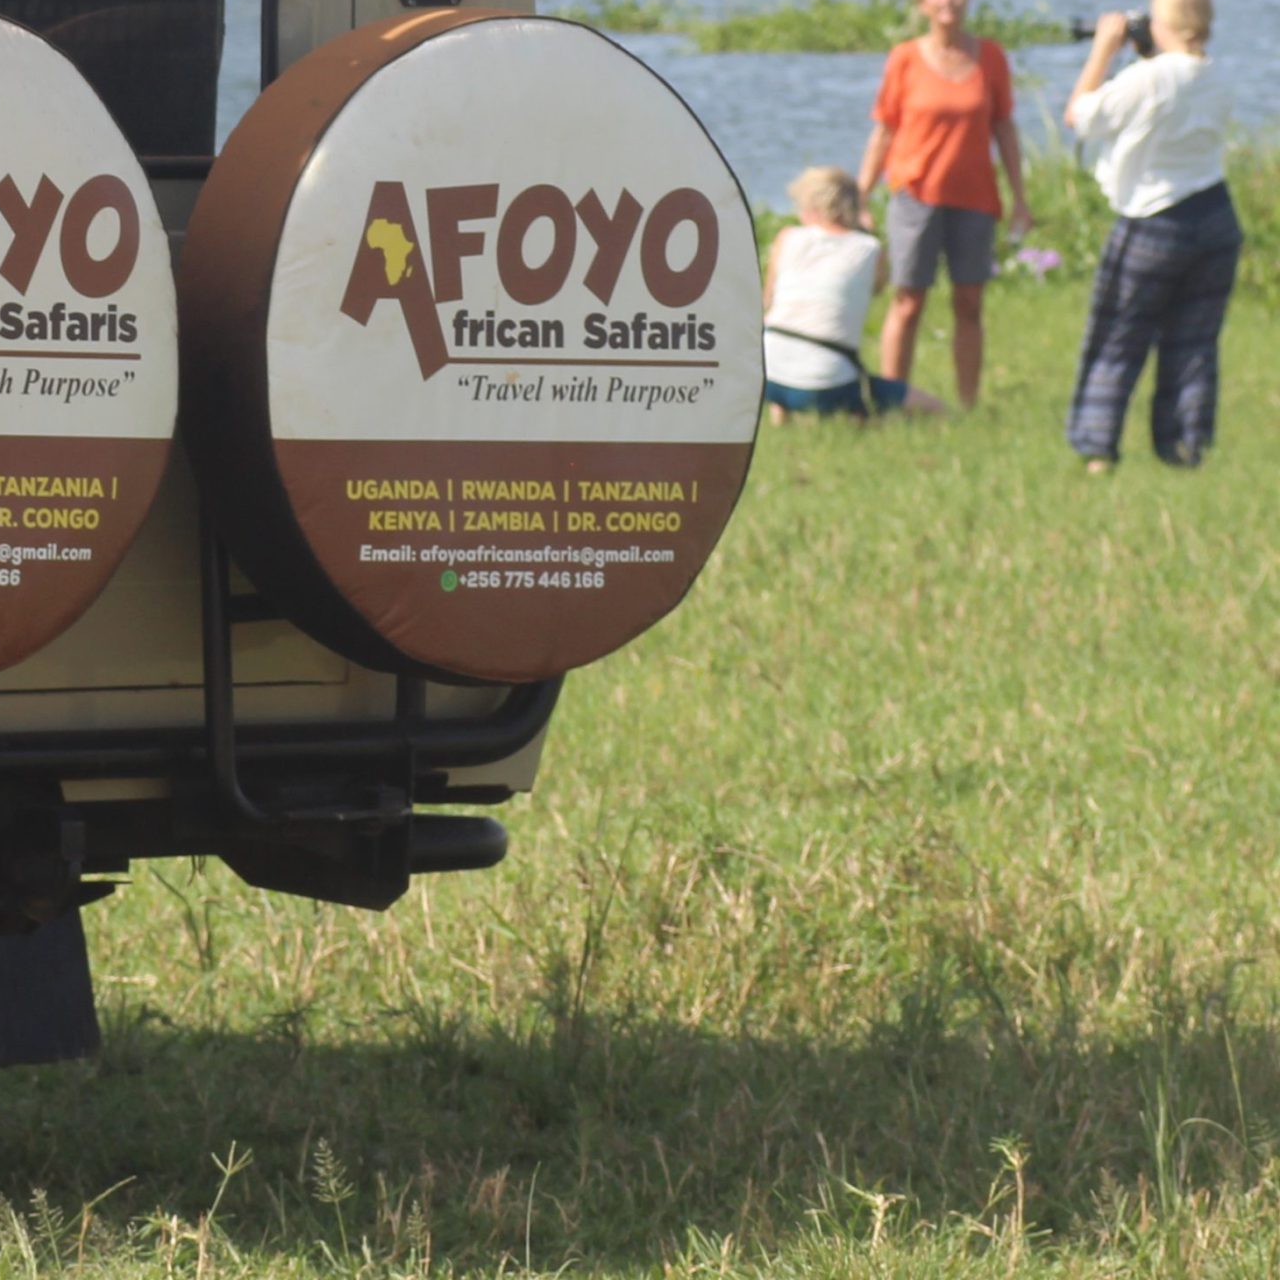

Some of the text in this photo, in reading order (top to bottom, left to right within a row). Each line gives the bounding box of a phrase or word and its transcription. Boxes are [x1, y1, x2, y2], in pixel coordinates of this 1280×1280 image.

[340, 181, 719, 381] AFOYO
[0, 301, 138, 343] Safaris
[583, 312, 716, 351] Safaris
[551, 376, 598, 402] with
[346, 480, 439, 500] UGANDA
[461, 480, 556, 501] RWANDA
[578, 481, 684, 502] TANZANIA
[23, 508, 100, 529] CONGO
[368, 511, 442, 531] KENYA
[463, 511, 545, 531] ZAMBIA
[567, 512, 601, 532] DR.
[605, 512, 682, 532] CONGO
[359, 544, 675, 568] Email: afoyoafricansafaris@gmail.com
[459, 571, 605, 588] +256 775 446 166
